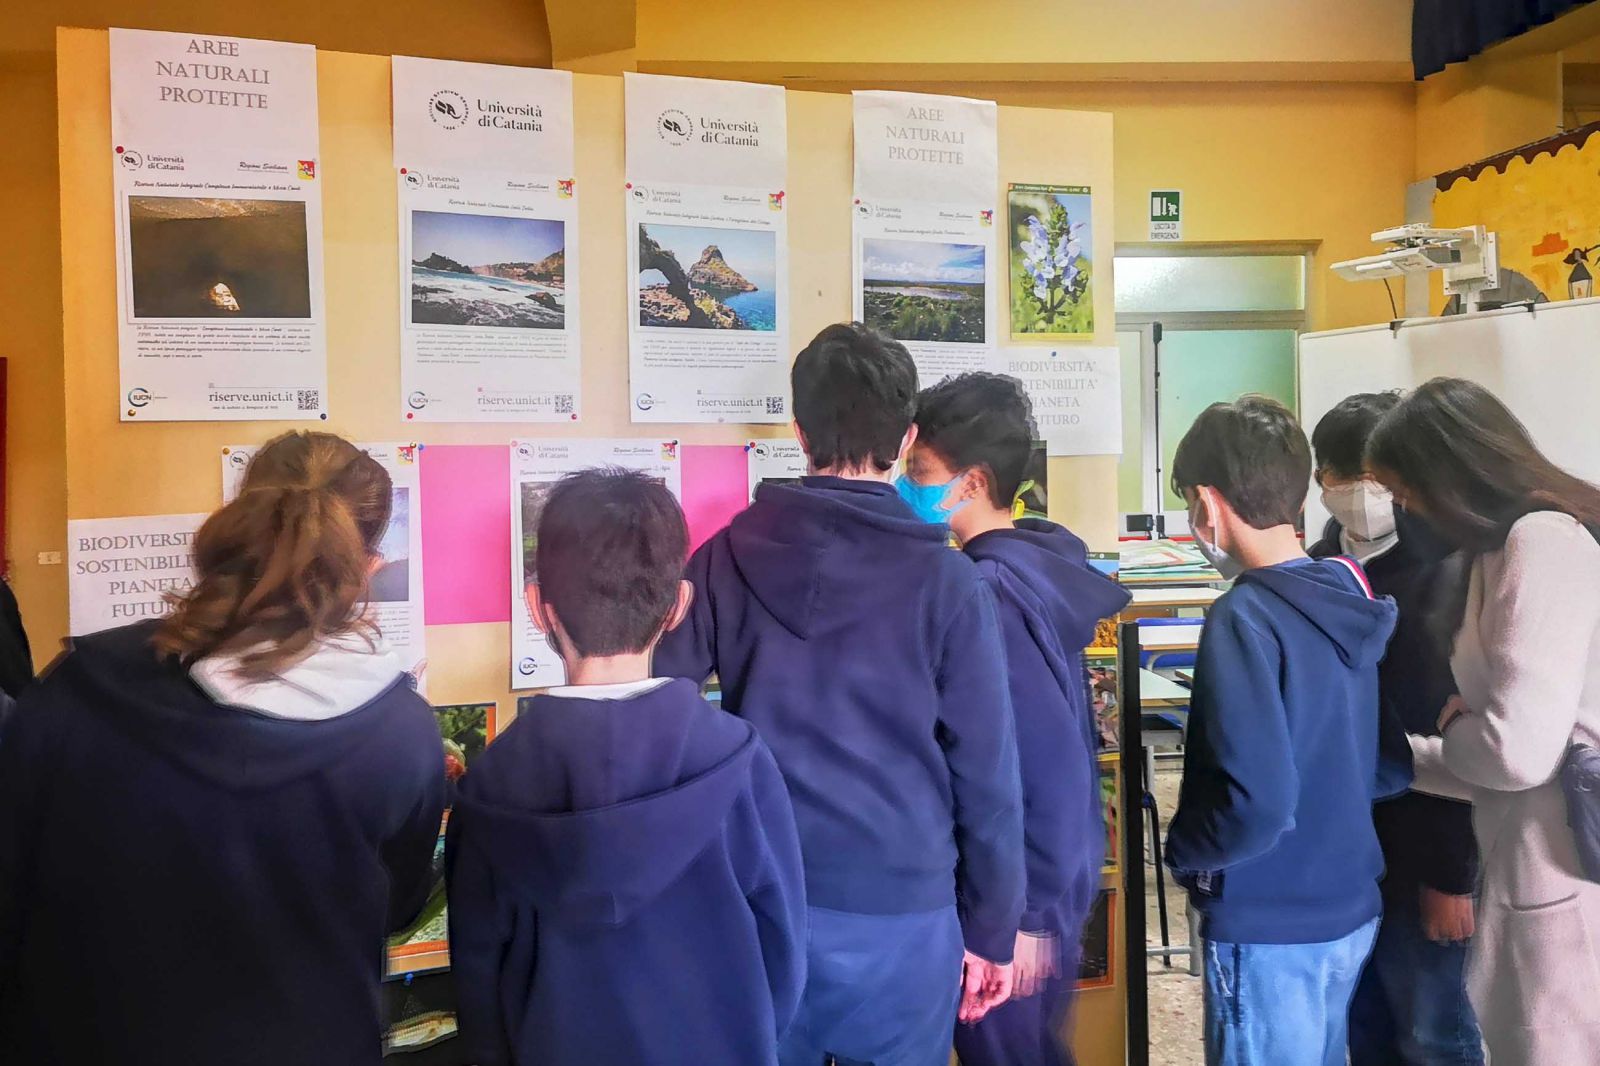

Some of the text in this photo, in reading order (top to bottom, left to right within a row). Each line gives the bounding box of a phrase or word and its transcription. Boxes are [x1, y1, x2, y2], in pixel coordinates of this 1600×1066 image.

[187, 39, 239, 57] AREE
[156, 60, 270, 85] NATURALI
[160, 86, 268, 109] PROTETTE
[477, 99, 543, 118] Università
[907, 107, 944, 122] AREE
[478, 115, 543, 132] di Catania
[700, 117, 759, 133] Università
[701, 131, 759, 147] di Catania
[886, 125, 965, 145] NATURALI
[147, 154, 184, 164] Università
[888, 146, 964, 165] PROTETTE
[156, 162, 185, 171] Catania
[1008, 361, 1096, 372] BIODIVERSITA'
[1023, 378, 1098, 390] STENIBILITA'
[208, 391, 294, 402] riserve.unict.it
[477, 395, 551, 406] riserve.unict.it
[697, 397, 763, 408] riserve.unict.it
[1035, 414, 1080, 425] UTURO
[79, 532, 198, 552] BIODIVERSIT
[76, 553, 194, 574] SOSTENIBILI
[109, 577, 193, 595] PIANETA
[112, 601, 176, 618] FUTUR
